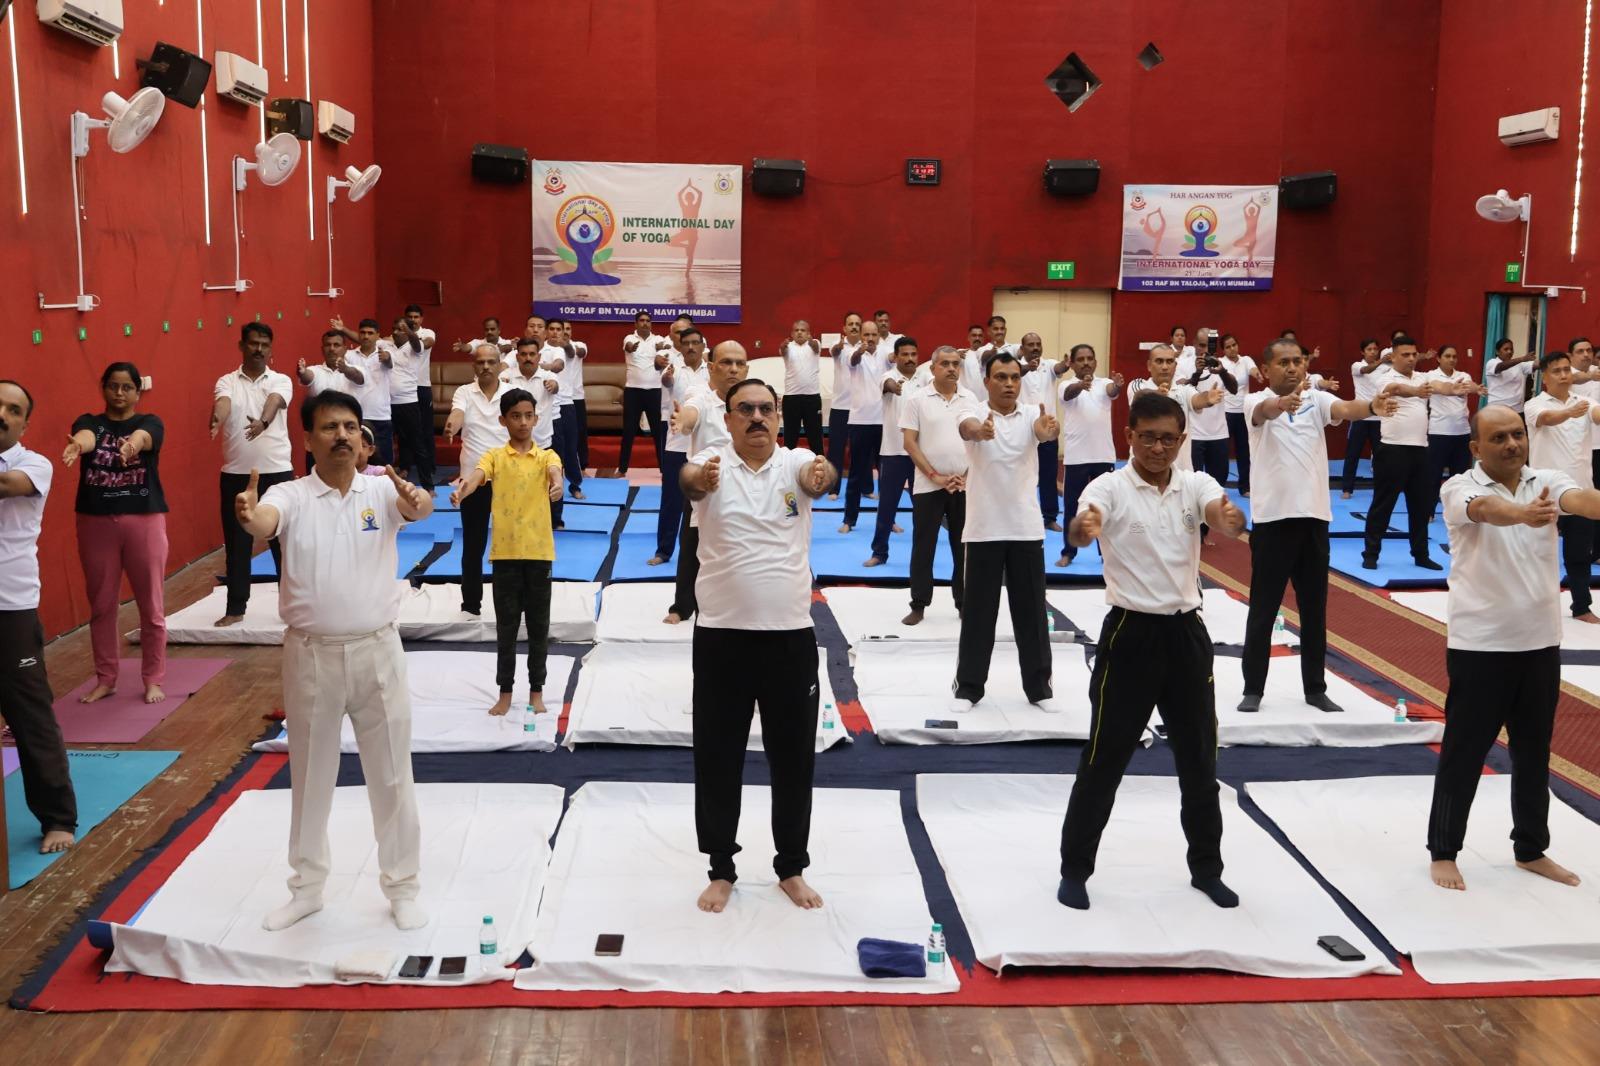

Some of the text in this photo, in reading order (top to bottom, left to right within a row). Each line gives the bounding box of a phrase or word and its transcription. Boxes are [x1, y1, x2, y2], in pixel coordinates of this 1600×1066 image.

[622, 217, 735, 229] INTERNATIONAL DAY
[622, 232, 671, 243] OF YOGA
[1051, 263, 1071, 271] EXIT
[1136, 260, 1261, 269] INTERNATIONAL YOGA DAY
[1507, 264, 1519, 272] EXIT
[559, 306, 576, 314] 102
[578, 307, 596, 315] RAF
[599, 307, 611, 315] BN
[654, 308, 676, 316] NAVI
